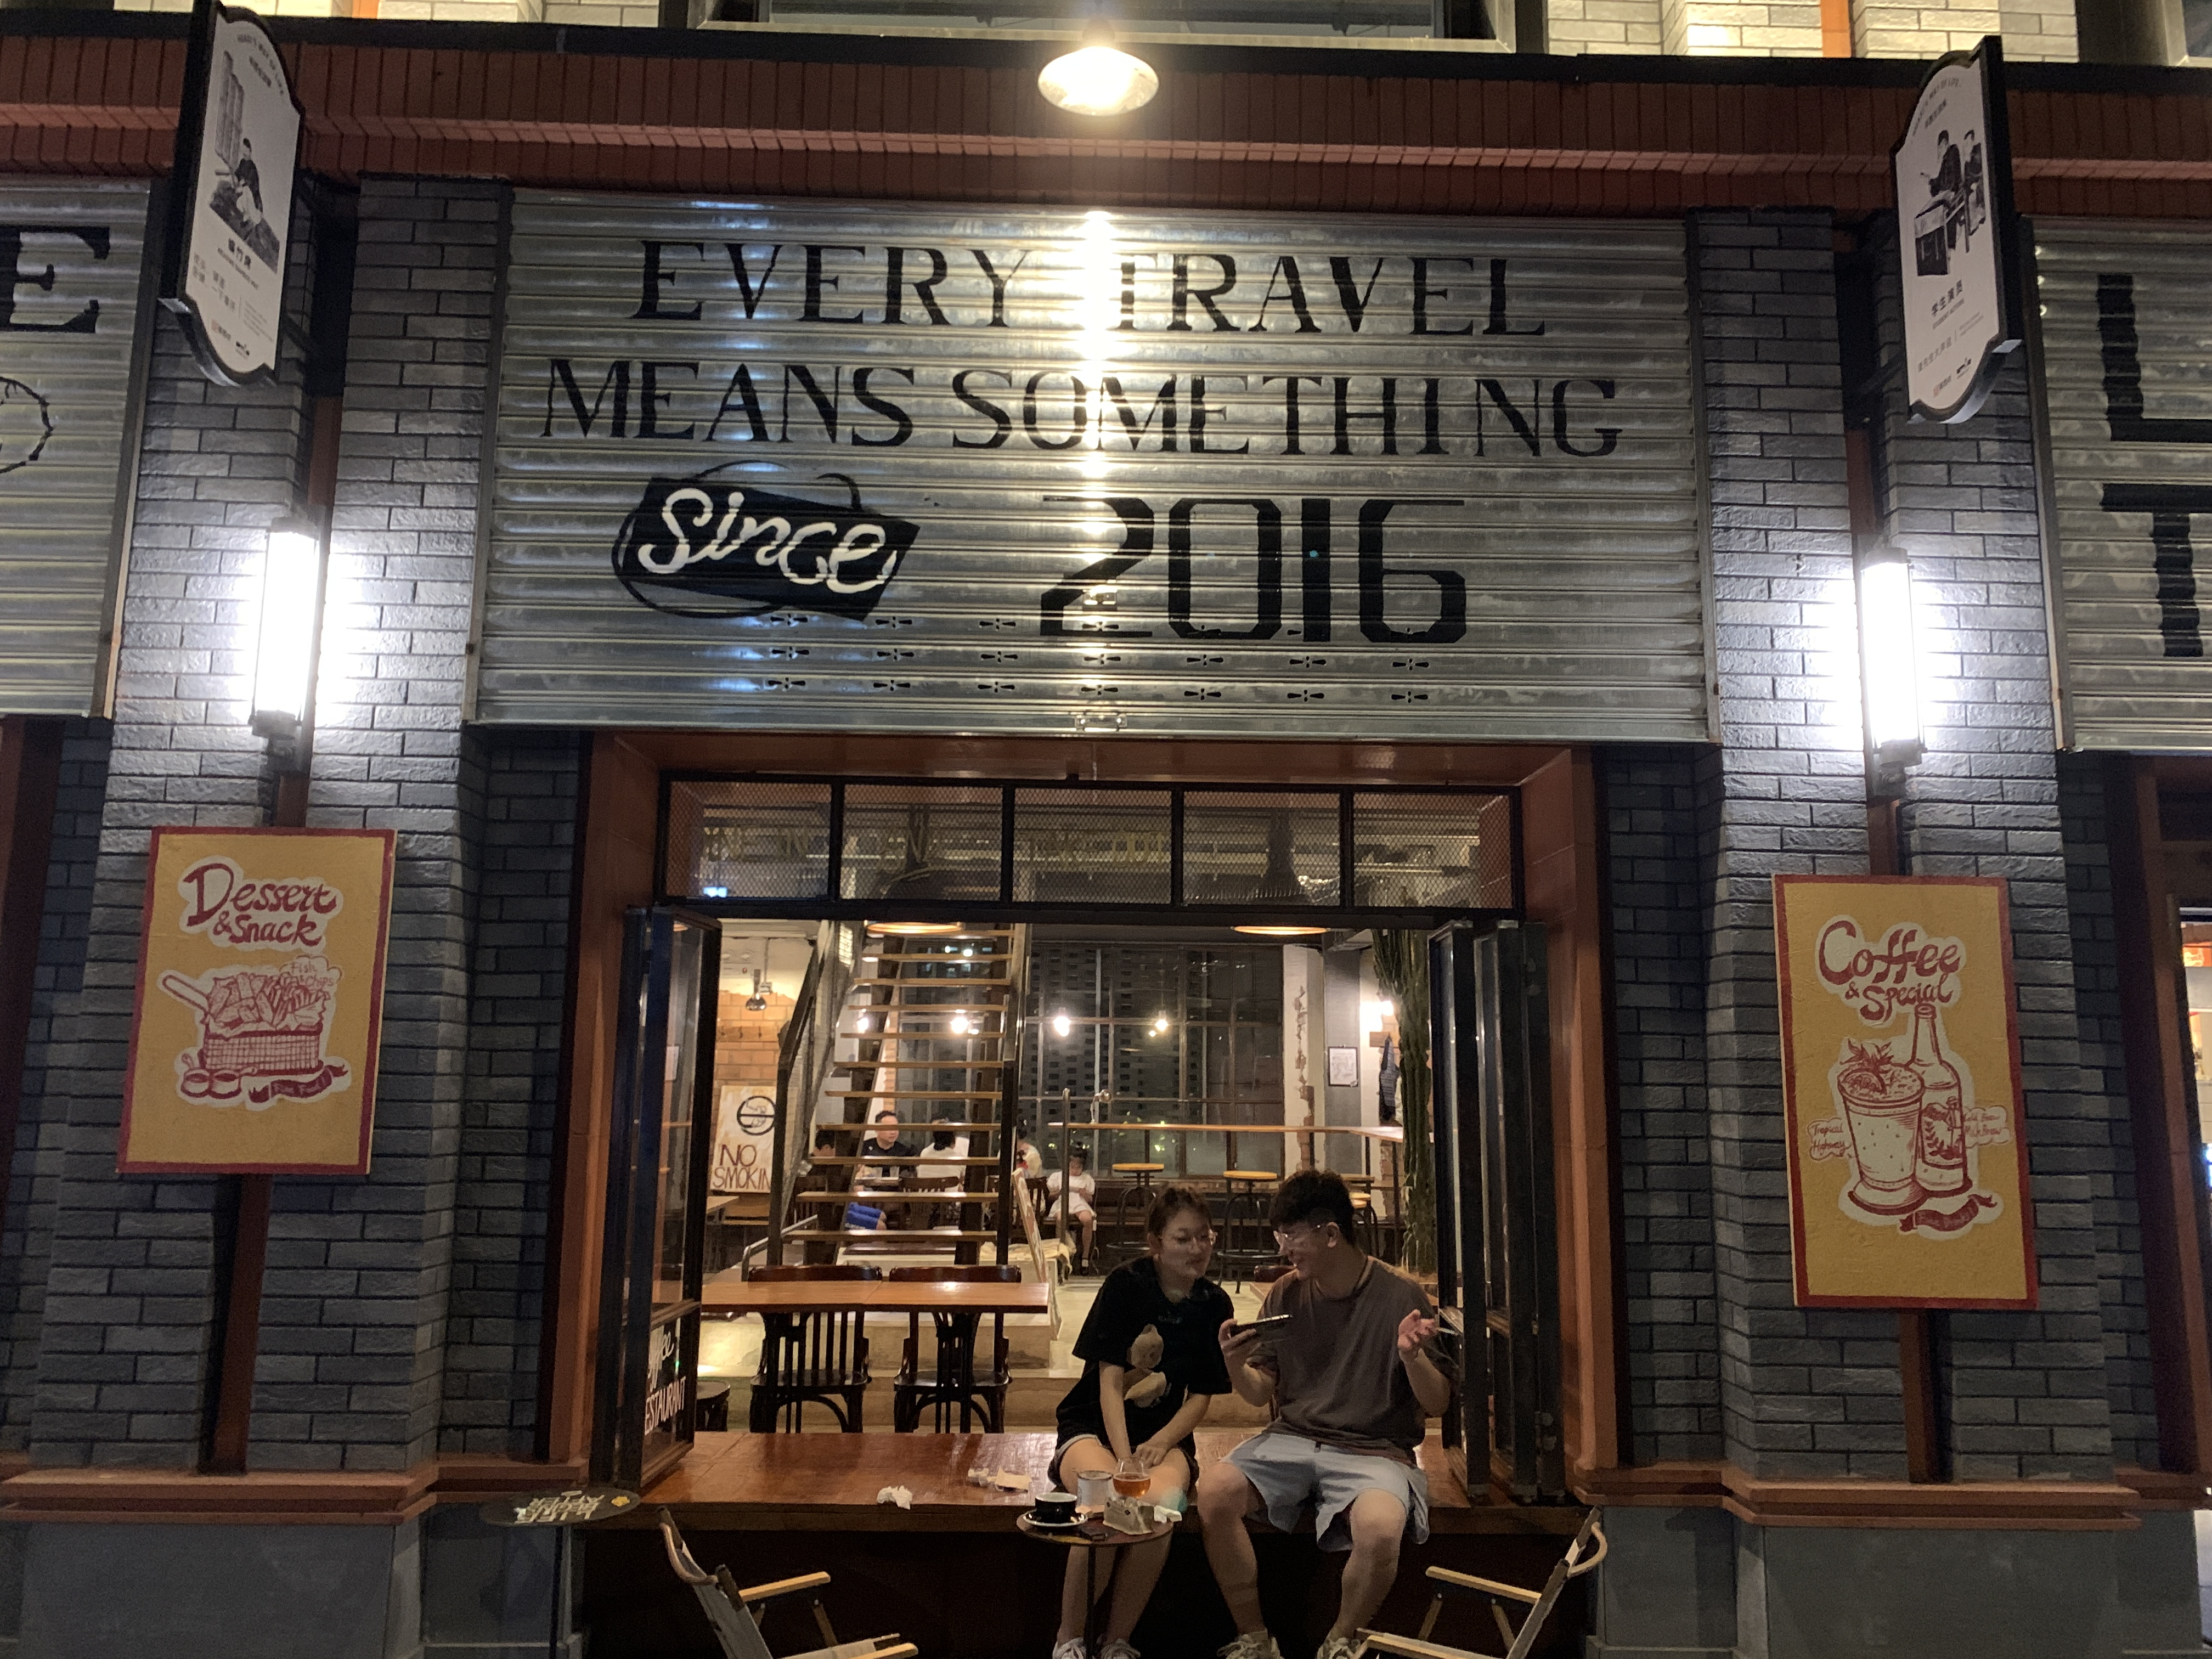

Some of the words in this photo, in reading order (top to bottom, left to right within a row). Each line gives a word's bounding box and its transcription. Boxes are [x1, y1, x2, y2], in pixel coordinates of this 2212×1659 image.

[627, 240, 1032, 328] EVERY
[1104, 252, 1545, 336] TRAVEL
[540, 358, 915, 447] MEANS
[952, 369, 1623, 458] SOMETHING
[638, 488, 898, 594] Since
[1040, 497, 1467, 644] 2016
[183, 862, 337, 927] Dessert
[213, 910, 232, 936] &
[229, 913, 322, 947] Snack
[1819, 920, 1961, 985] Coffee
[1844, 981, 1860, 1000] &
[1860, 972, 1954, 1023] Special
[713, 1166, 771, 1190] SMOKIN
[719, 1143, 757, 1167] NO
[644, 1375, 686, 1436] ESTAURANT
